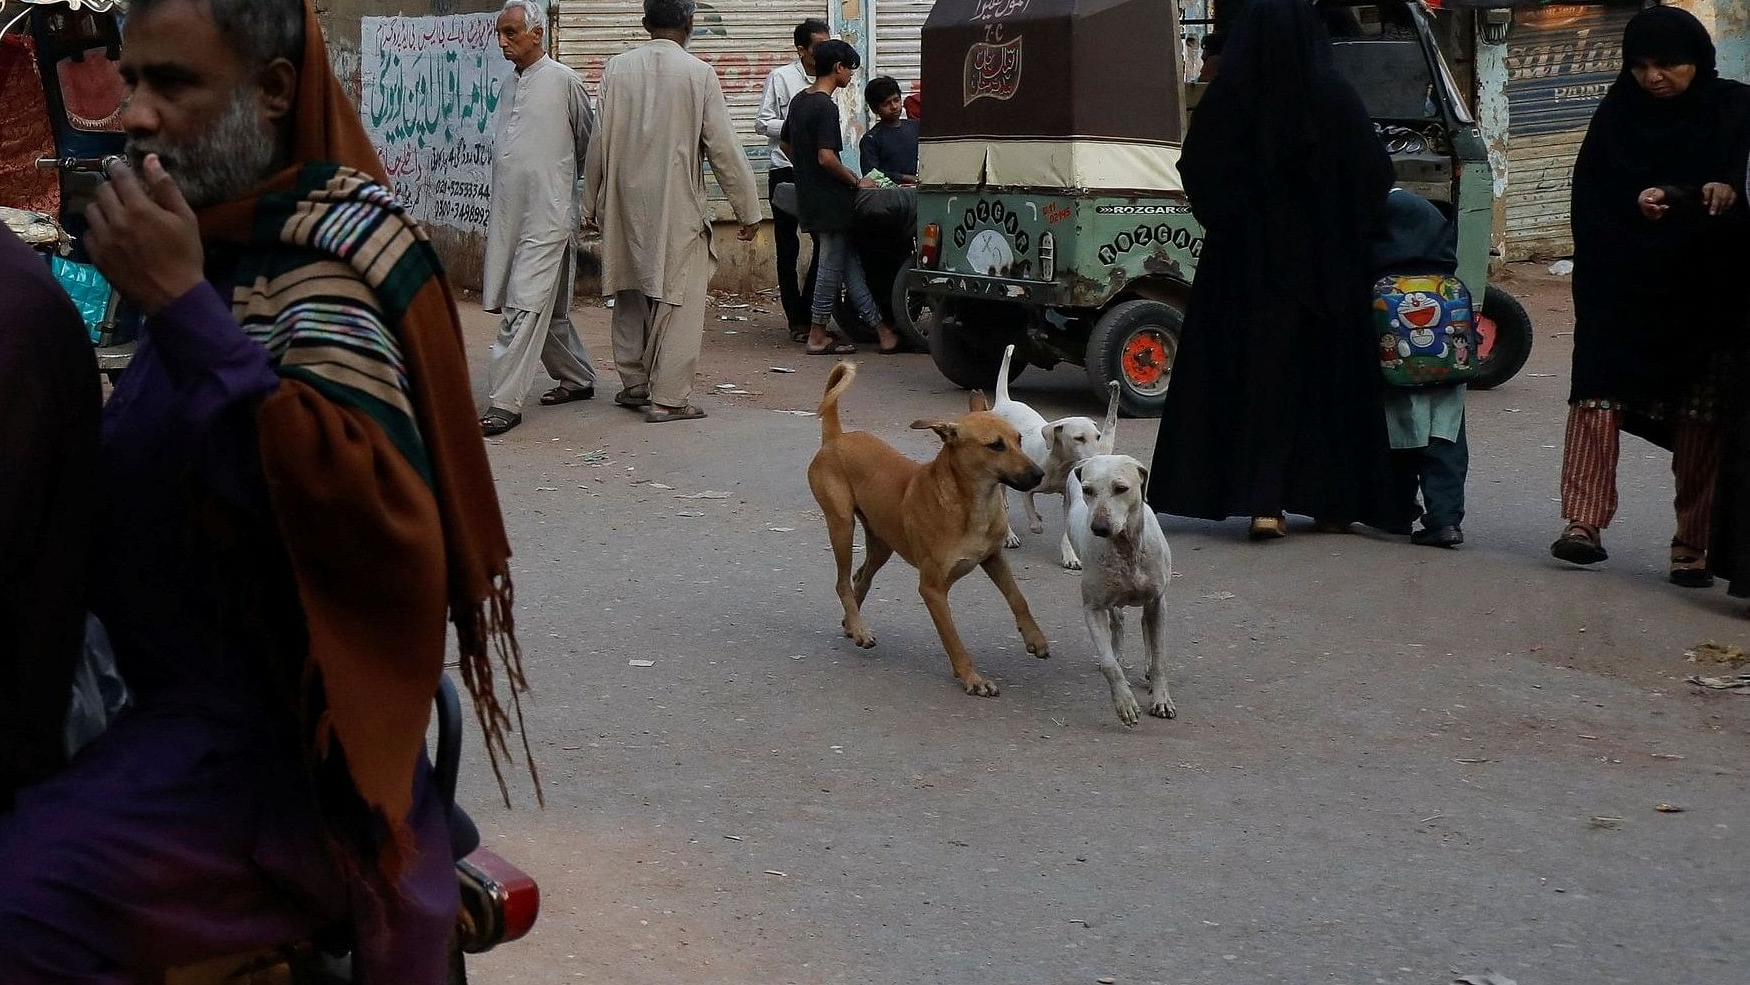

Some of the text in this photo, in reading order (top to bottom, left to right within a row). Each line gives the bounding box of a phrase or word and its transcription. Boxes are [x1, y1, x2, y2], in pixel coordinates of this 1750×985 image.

[954, 198, 1030, 257] ROZGAR
[1113, 205, 1177, 214] ROZGAR
[1099, 223, 1204, 266] ROZGAR
